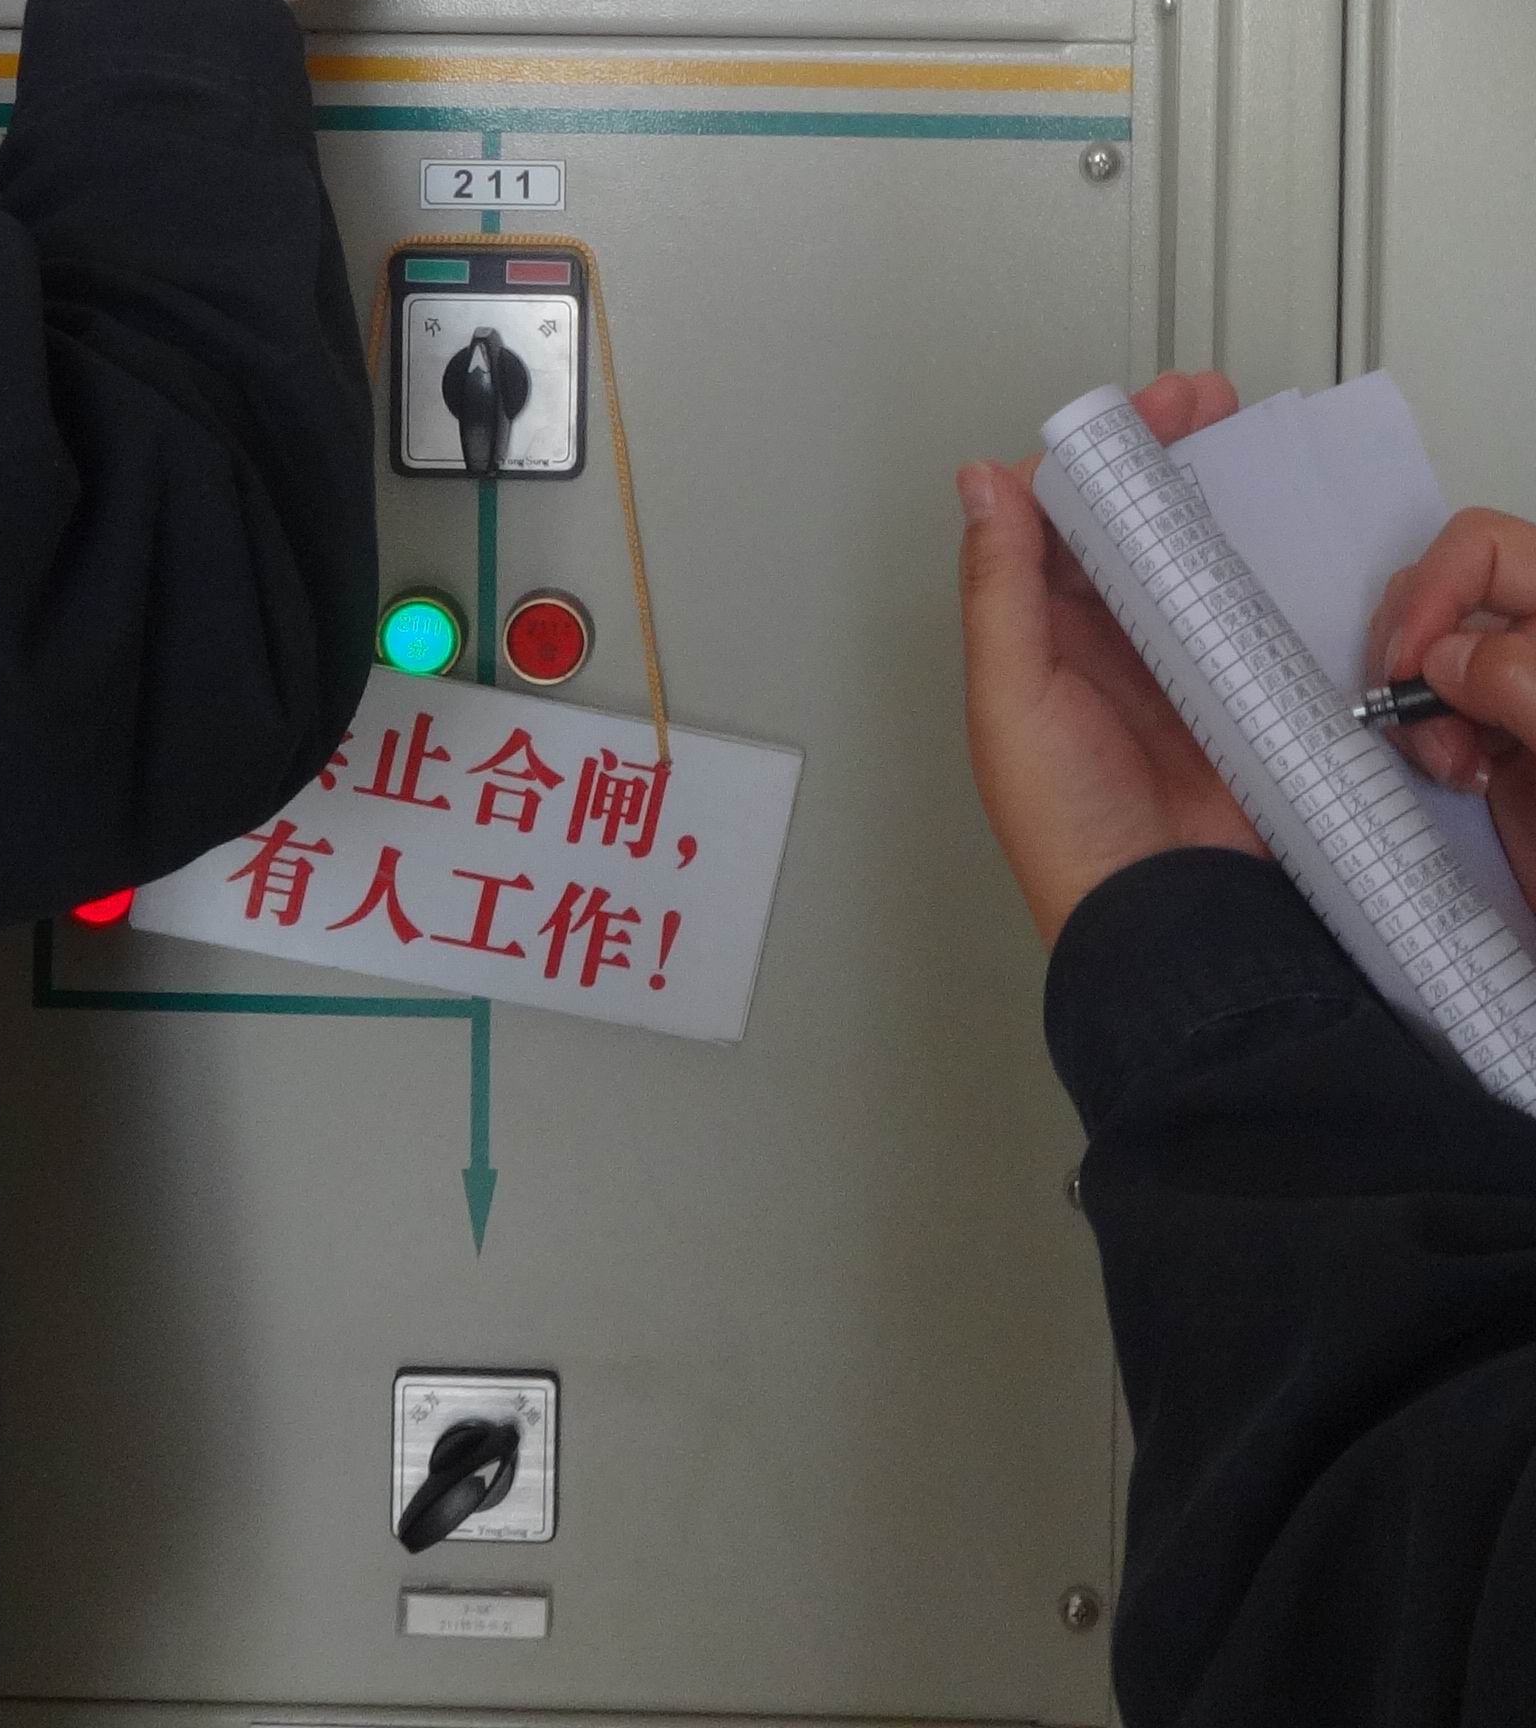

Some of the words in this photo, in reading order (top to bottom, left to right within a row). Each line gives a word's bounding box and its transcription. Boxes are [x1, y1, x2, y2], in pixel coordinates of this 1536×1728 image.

[451, 169, 533, 201] 211
[226, 819, 684, 992] 有人工作!
